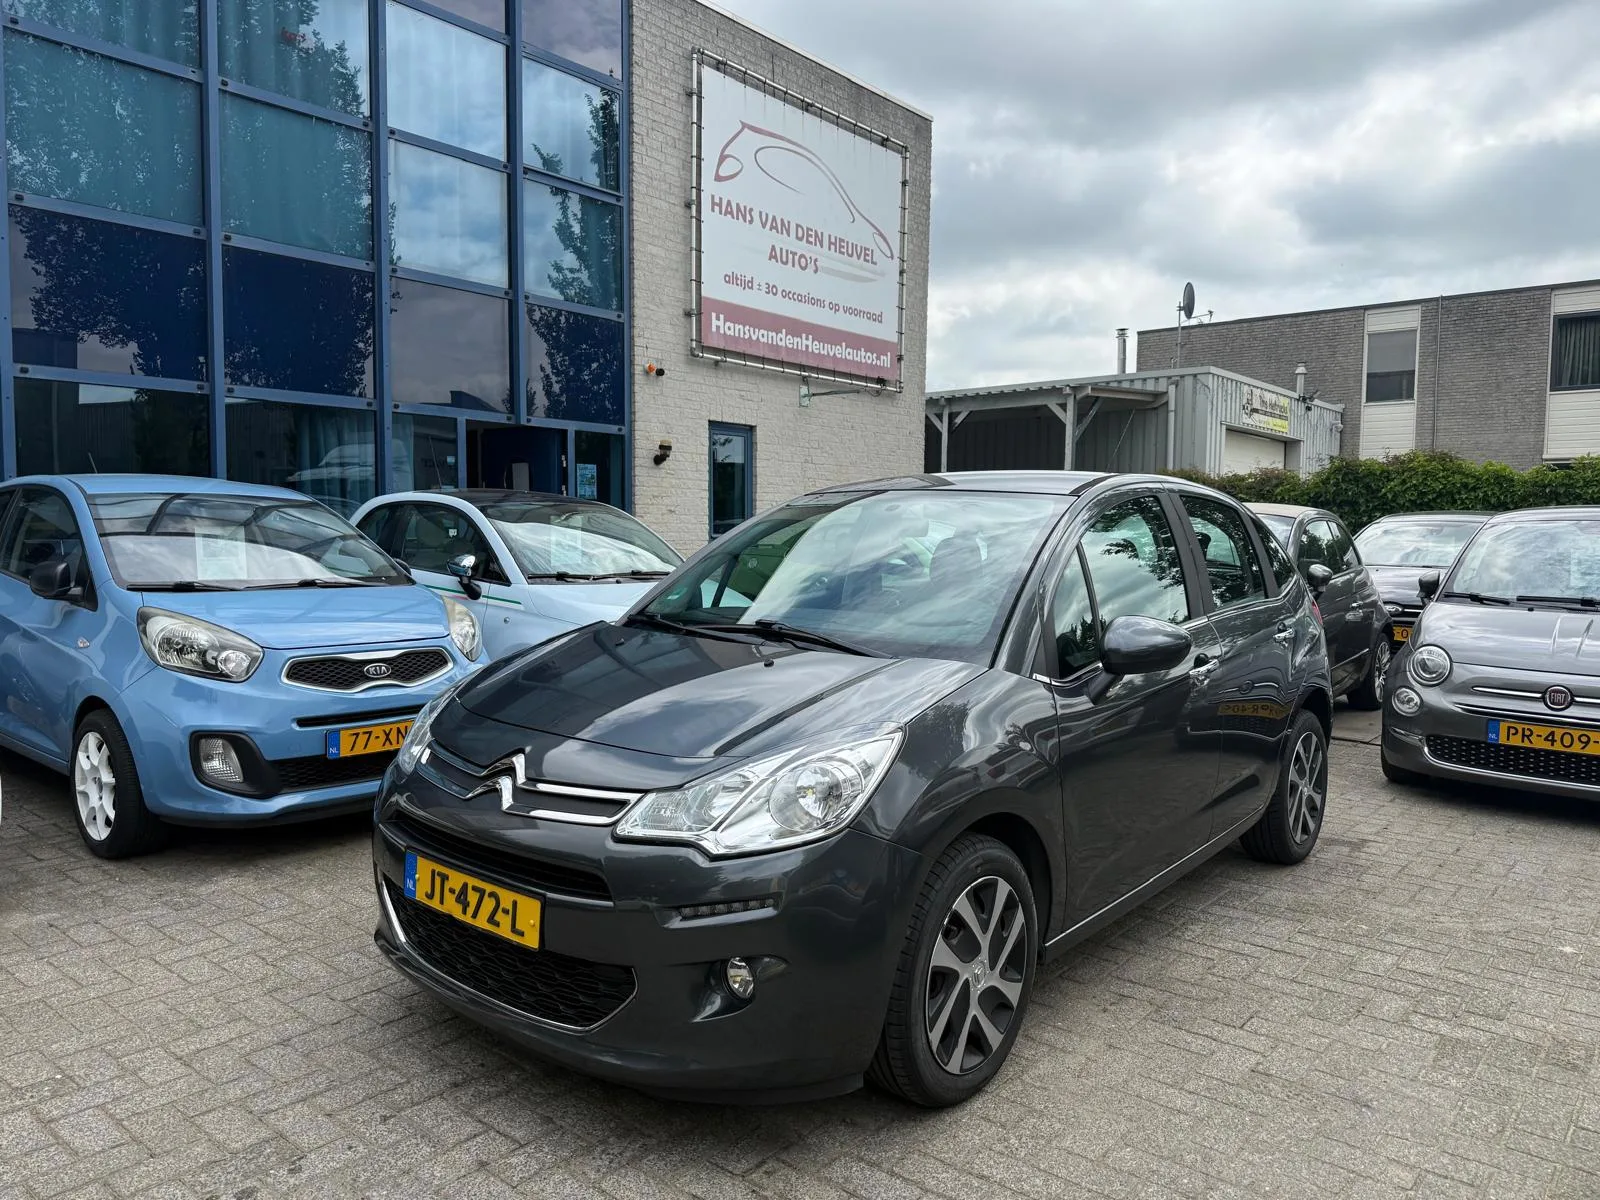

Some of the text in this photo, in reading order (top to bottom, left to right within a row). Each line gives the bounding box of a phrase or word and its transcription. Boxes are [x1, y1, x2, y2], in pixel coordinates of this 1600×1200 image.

[711, 194, 877, 265] HANS VAN DEN HEUVEL
[768, 244, 819, 274] AUTO'S
[724, 272, 754, 291] altijd
[765, 283, 778, 296] 30
[781, 289, 826, 309] occasions
[828, 301, 840, 314] op
[843, 304, 883, 323] voorraad
[711, 312, 891, 368] HansvandenHeuvelautos.nl
[369, 666, 388, 675] KIA
[1550, 692, 1566, 704] FIAT
[1488, 732, 1498, 740] NL
[406, 868, 525, 937] NL JT-472-L
